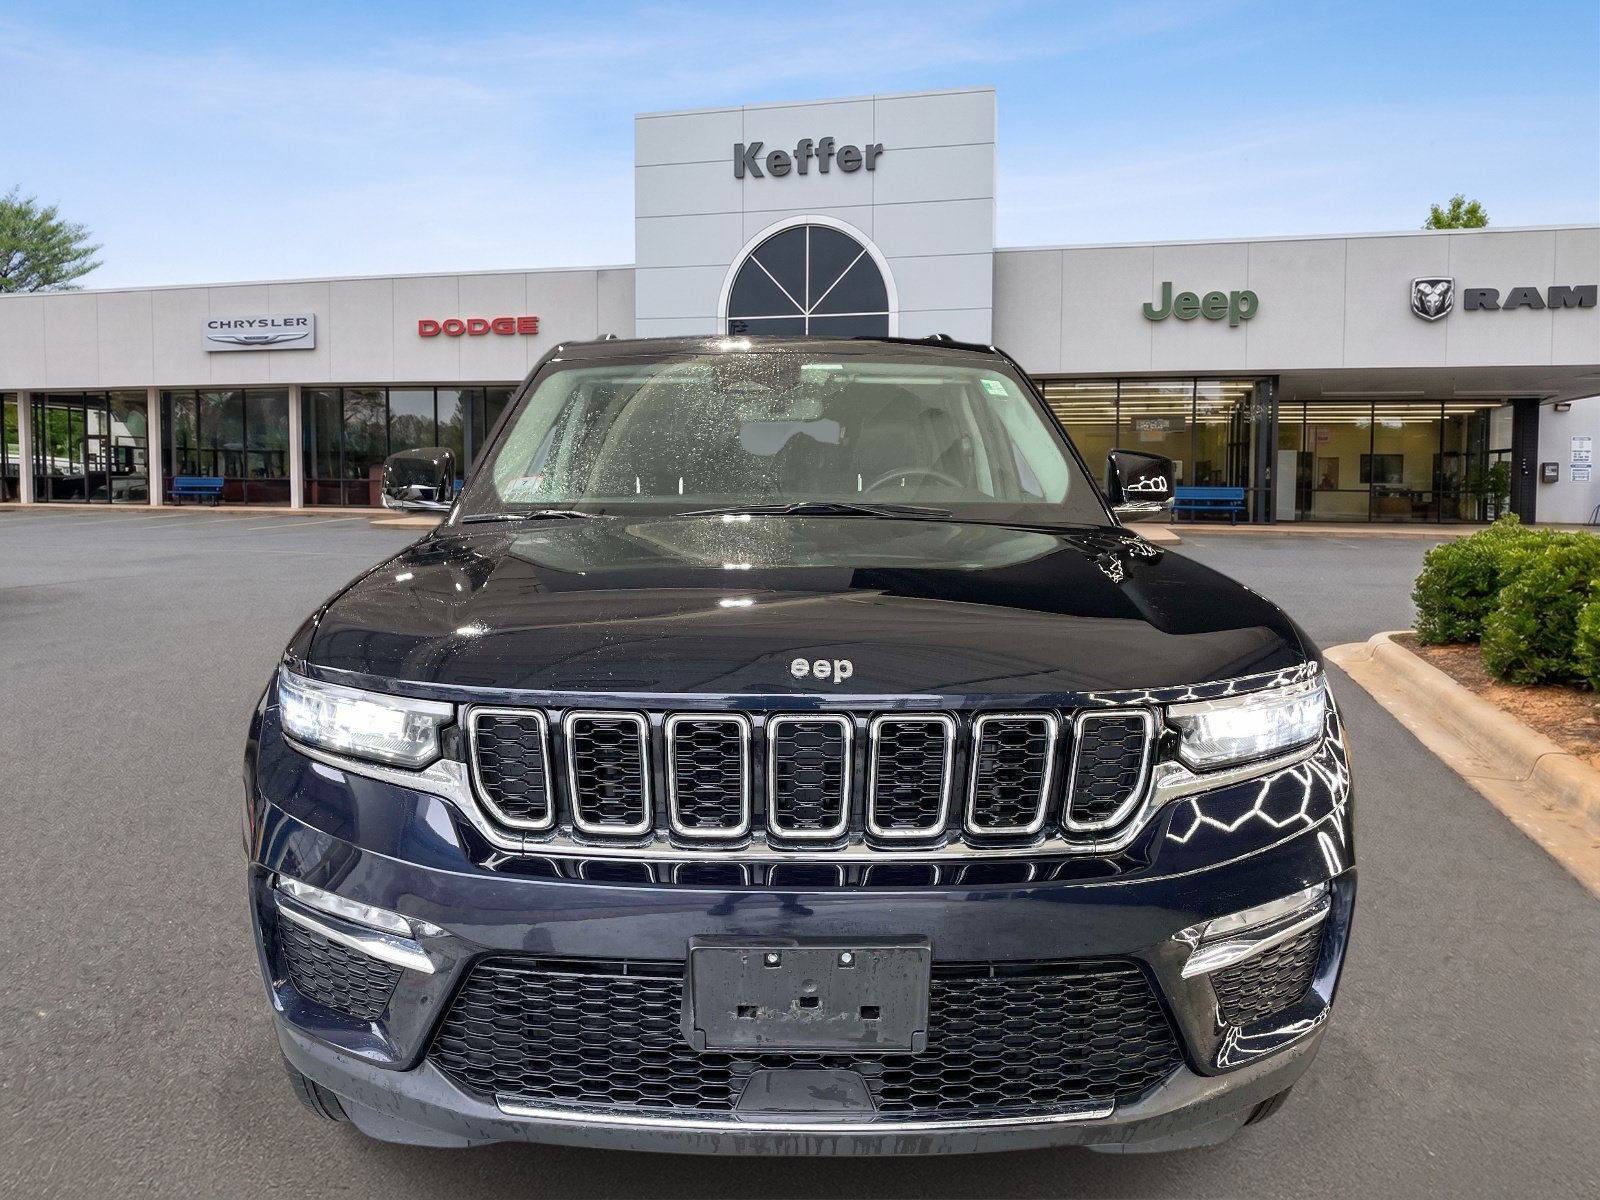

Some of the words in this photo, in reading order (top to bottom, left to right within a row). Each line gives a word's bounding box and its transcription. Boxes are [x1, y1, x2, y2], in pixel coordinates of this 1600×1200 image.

[733, 136, 884, 179] Keffer
[1142, 281, 1259, 328] Jeep
[1463, 285, 1598, 311] RAM
[207, 317, 308, 330] CHRYSLER
[418, 316, 539, 338] DODGE
[790, 657, 853, 685] eep
